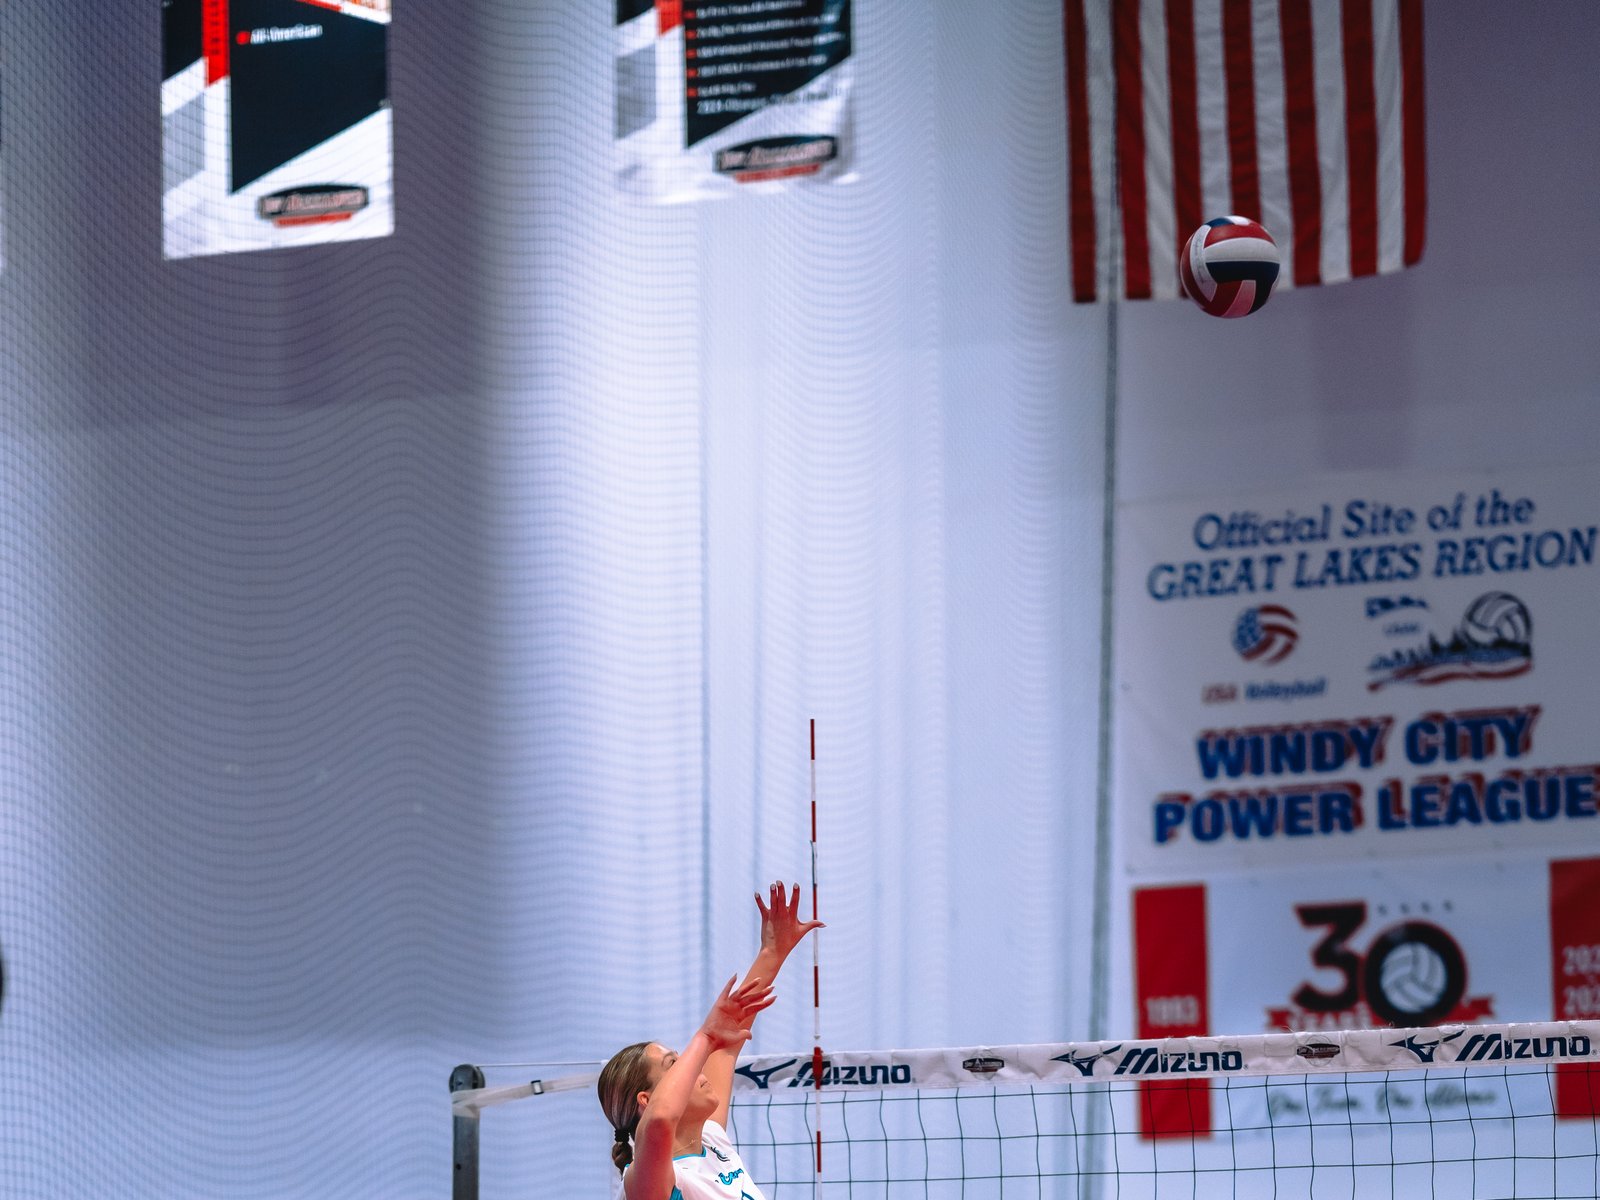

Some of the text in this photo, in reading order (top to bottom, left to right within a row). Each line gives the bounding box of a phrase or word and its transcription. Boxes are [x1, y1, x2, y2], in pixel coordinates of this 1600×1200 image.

[1193, 489, 1534, 551] Official Site of the
[1147, 527, 1598, 601] GREAT LAKES REGION
[1196, 705, 1542, 780] WINDY CITY
[1153, 765, 1600, 844] POWER LEAGUE
[1291, 899, 1468, 1028] 30
